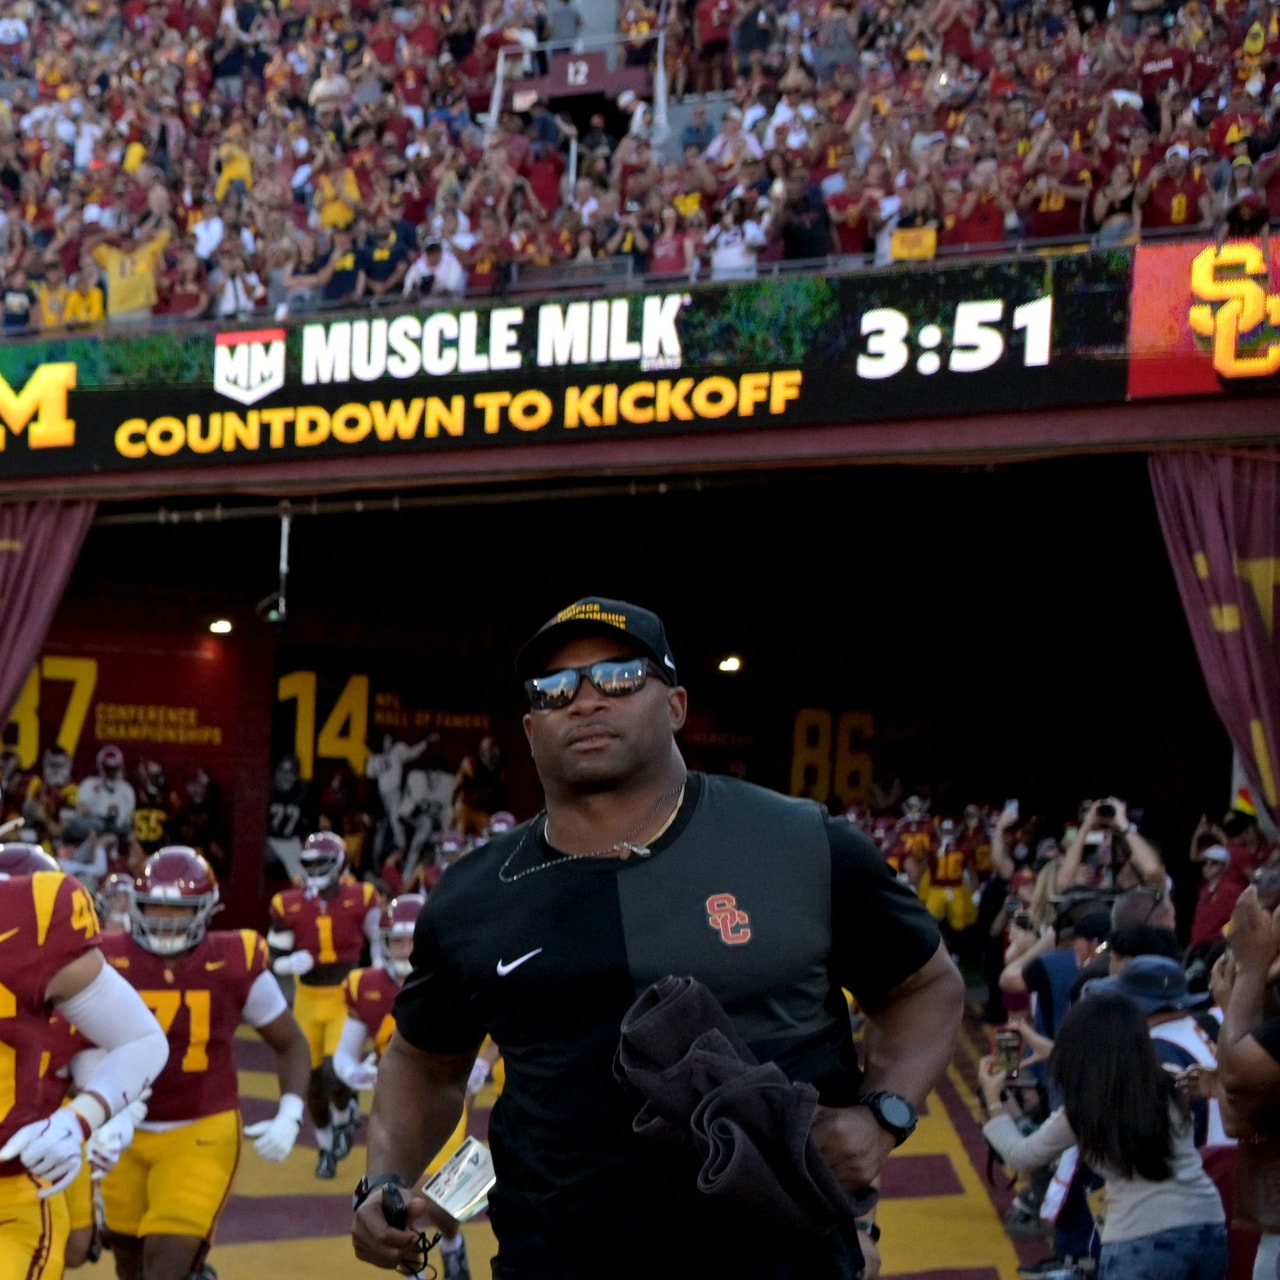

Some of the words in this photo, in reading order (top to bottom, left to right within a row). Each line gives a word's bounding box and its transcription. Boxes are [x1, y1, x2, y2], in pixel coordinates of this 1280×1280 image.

[567, 60, 588, 86] 12
[301, 306, 524, 385] MUSCLE
[537, 294, 683, 368] MILK
[856, 295, 1053, 380] 3:51
[114, 395, 465, 459] COUNTDOWN
[473, 389, 553, 434] TO
[564, 370, 802, 429] KICKOFF
[94, 723, 222, 746] CHAMPIONSHIPS
[95, 703, 198, 725] CONFERENCE
[277, 670, 370, 780] 14
[791, 708, 875, 801] 86
[315, 916, 338, 963] 1
[706, 893, 750, 945] SC
